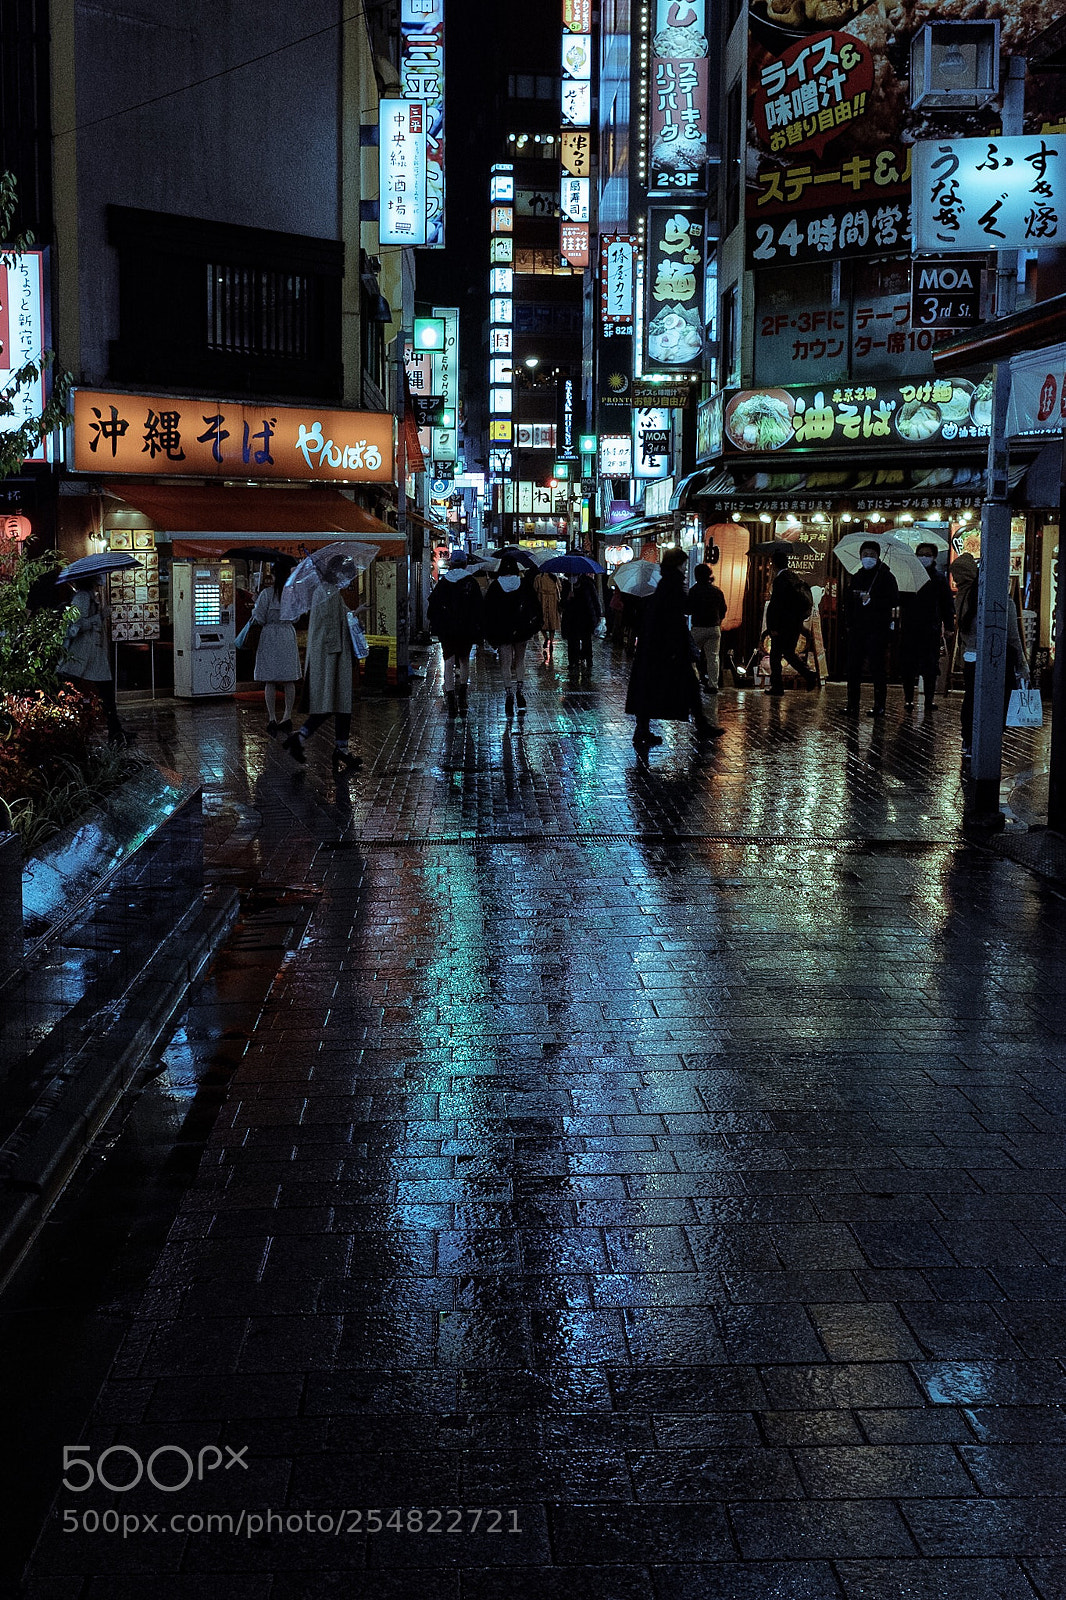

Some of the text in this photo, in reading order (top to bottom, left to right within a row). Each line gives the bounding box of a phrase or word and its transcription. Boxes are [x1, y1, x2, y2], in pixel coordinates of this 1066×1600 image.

[760, 36, 861, 97] ライス&
[656, 63, 680, 142] ハンバーグ
[678, 62, 702, 140] ステーキ&
[764, 68, 846, 130] 味噌汁
[770, 92, 866, 152] お替り自由!!
[388, 112, 407, 216] 中央線酒場
[930, 145, 965, 243] うなぎ
[975, 143, 1014, 239] ふぐ
[1024, 140, 1058, 239] すき焼
[919, 268, 974, 290] MOA
[919, 297, 972, 324] 3rd St.
[417, 398, 440, 410] モア
[792, 391, 896, 443] 油そば
[899, 378, 954, 404] つけ麺
[88, 405, 382, 470] 沖縄そば やんばる
[437, 461, 453, 470] モア
[645, 432, 667, 441] MOA
[799, 532, 827, 543] 神戸牛
